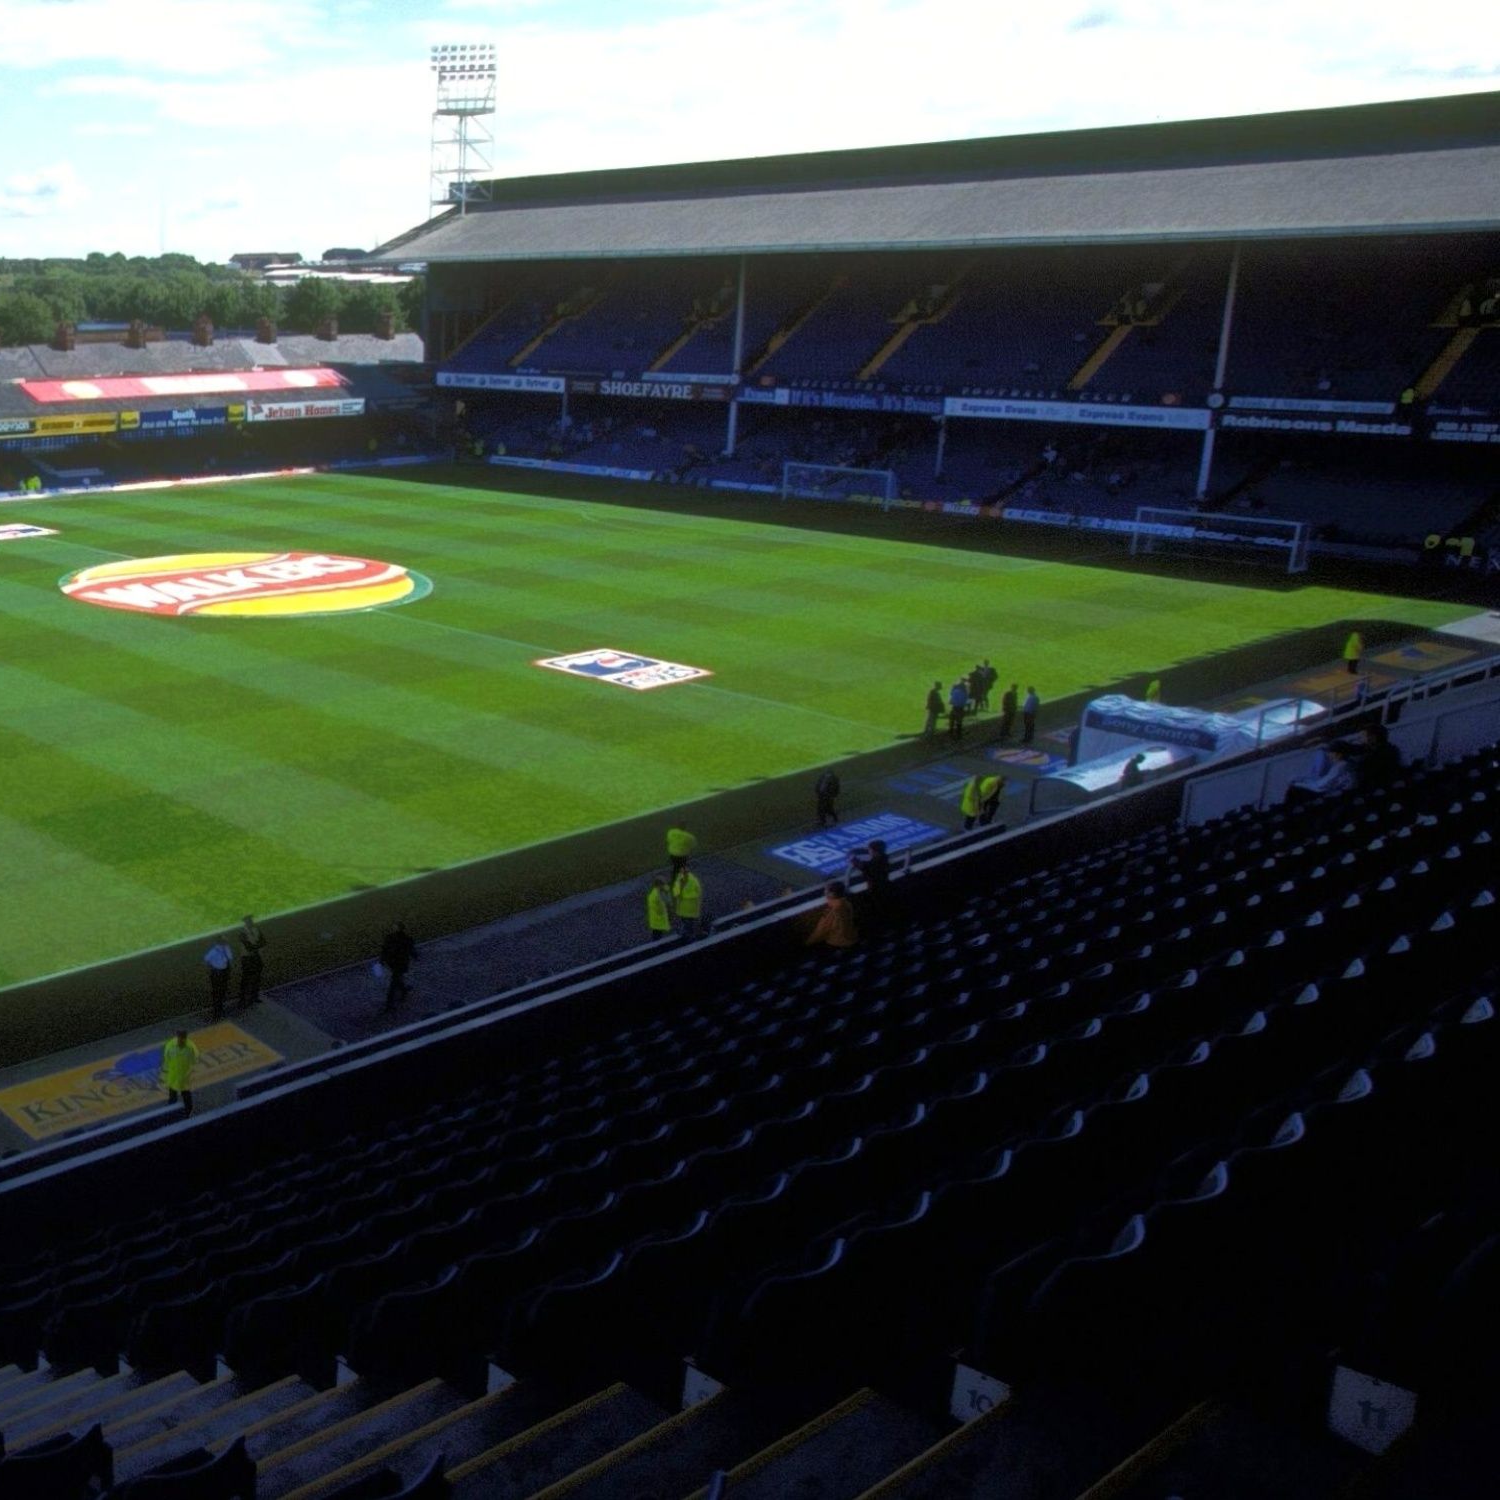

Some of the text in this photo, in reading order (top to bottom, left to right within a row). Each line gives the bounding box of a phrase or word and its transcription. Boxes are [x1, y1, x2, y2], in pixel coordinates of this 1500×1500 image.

[600, 381, 692, 399] SHOEFAYRE
[265, 406, 302, 419] Jelson
[304, 404, 340, 417] Homes
[961, 403, 1002, 414] Express
[1004, 405, 1036, 414] Evans
[1078, 409, 1124, 420] Express
[1128, 411, 1165, 421] Evans
[1221, 414, 1412, 436] Robinsons Mazda
[80, 554, 366, 608] WALKERS
[1143, 722, 1199, 742] Centre
